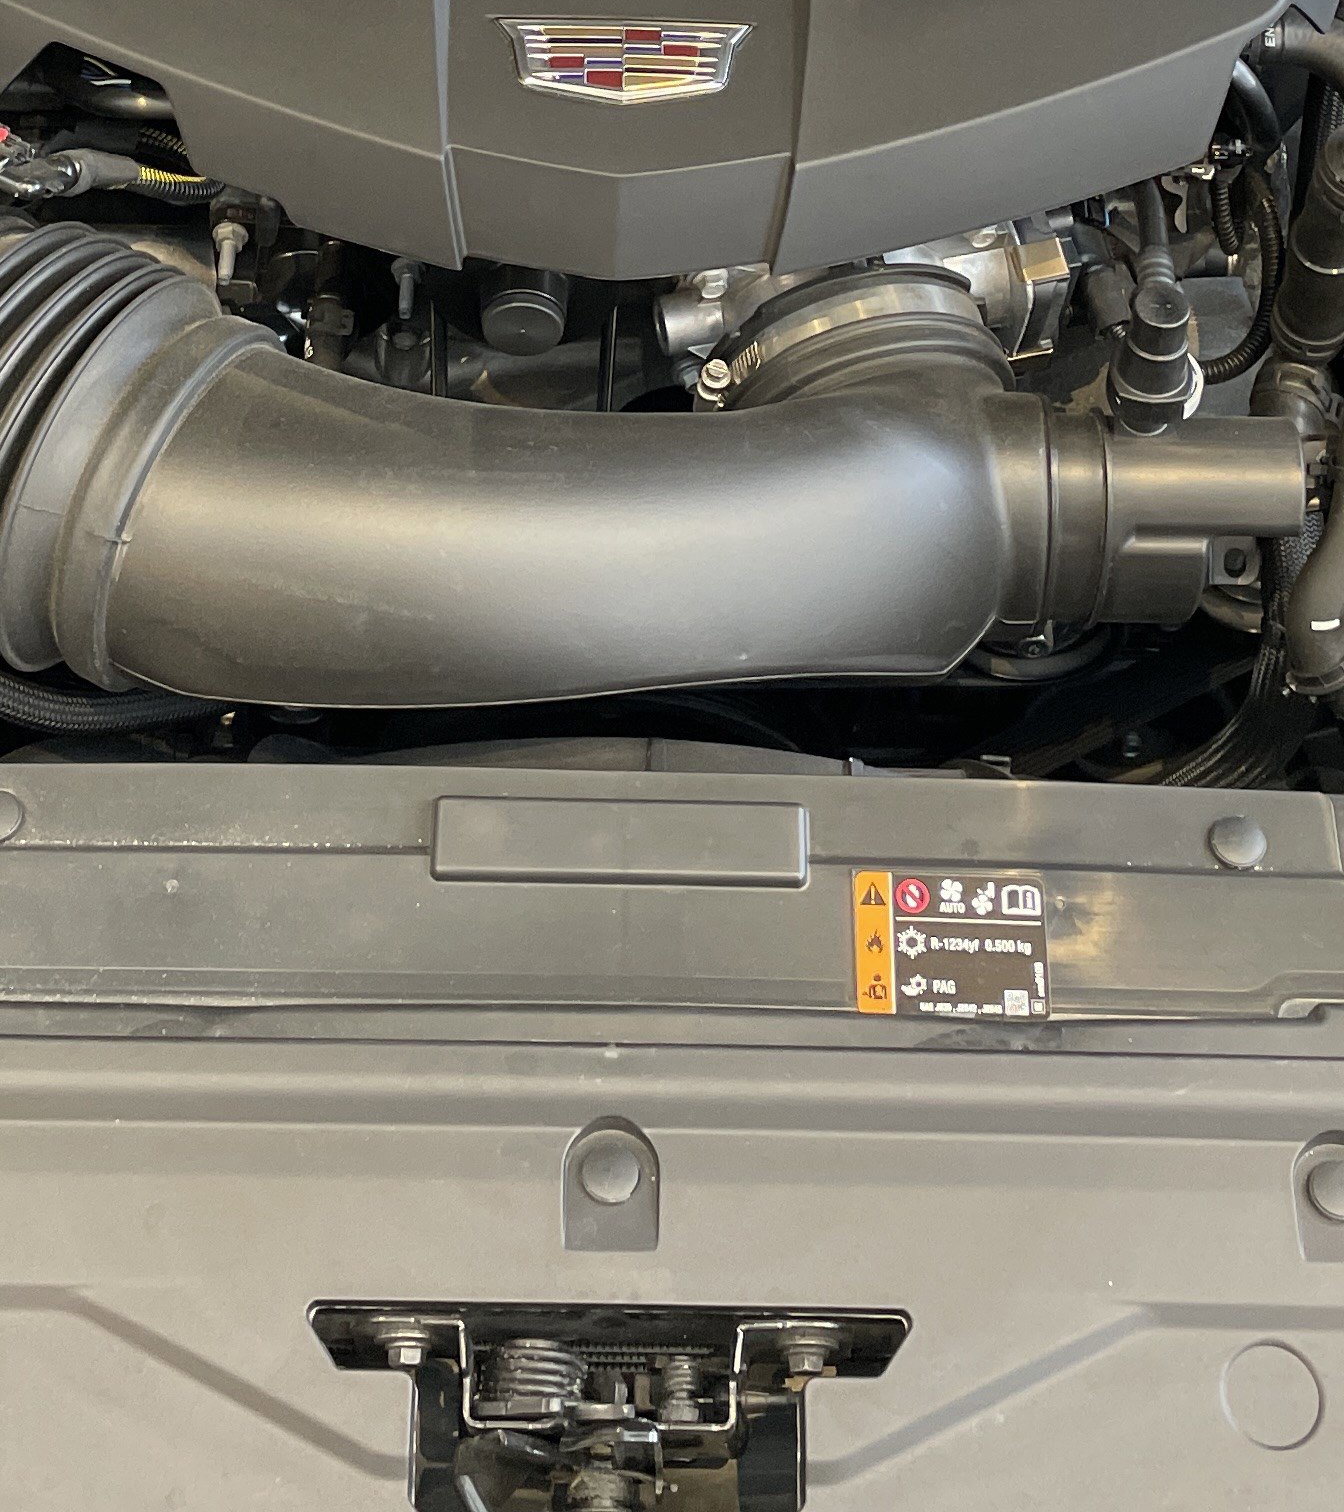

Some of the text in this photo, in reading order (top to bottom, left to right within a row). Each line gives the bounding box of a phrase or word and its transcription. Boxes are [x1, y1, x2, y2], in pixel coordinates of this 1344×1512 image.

[1264, 28, 1276, 48] EN
[939, 902, 966, 915] AUTO
[930, 936, 979, 954] R-1234yf
[1017, 939, 1032, 956] kg
[932, 979, 957, 995] PAG
